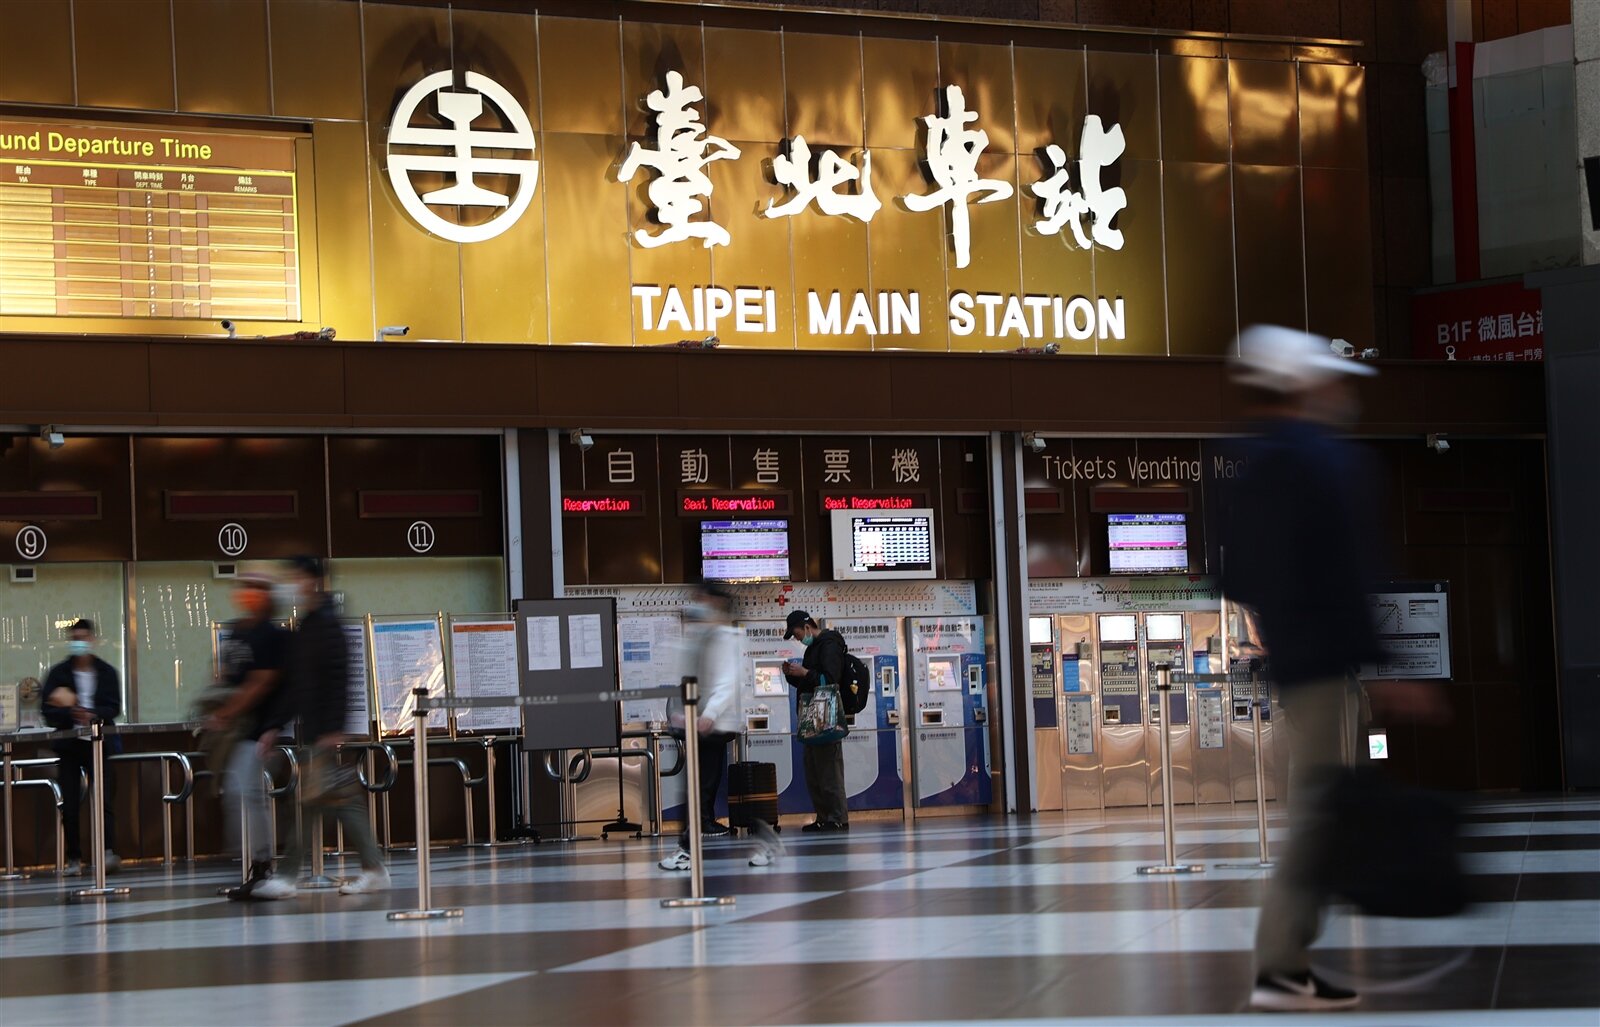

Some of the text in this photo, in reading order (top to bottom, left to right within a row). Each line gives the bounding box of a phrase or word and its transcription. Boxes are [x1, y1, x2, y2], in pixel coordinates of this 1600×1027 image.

[48, 132, 154, 158] Departure
[160, 138, 212, 160] Time
[180, 173, 195, 183] 月台
[617, 70, 1128, 269] 臺北車站
[234, 185, 258, 193] REMARKS
[632, 285, 1126, 341] TAIPEI MAIN STATION
[1437, 320, 1472, 345] B1F
[607, 448, 920, 484] 自動售票機
[1041, 455, 1117, 480] Tickets
[1127, 456, 1201, 482] Vending
[563, 498, 630, 511] Reservation
[683, 497, 775, 511] Seat Reservation
[825, 496, 912, 509] Seat Reservation
[746, 627, 787, 638] 對號列車自動
